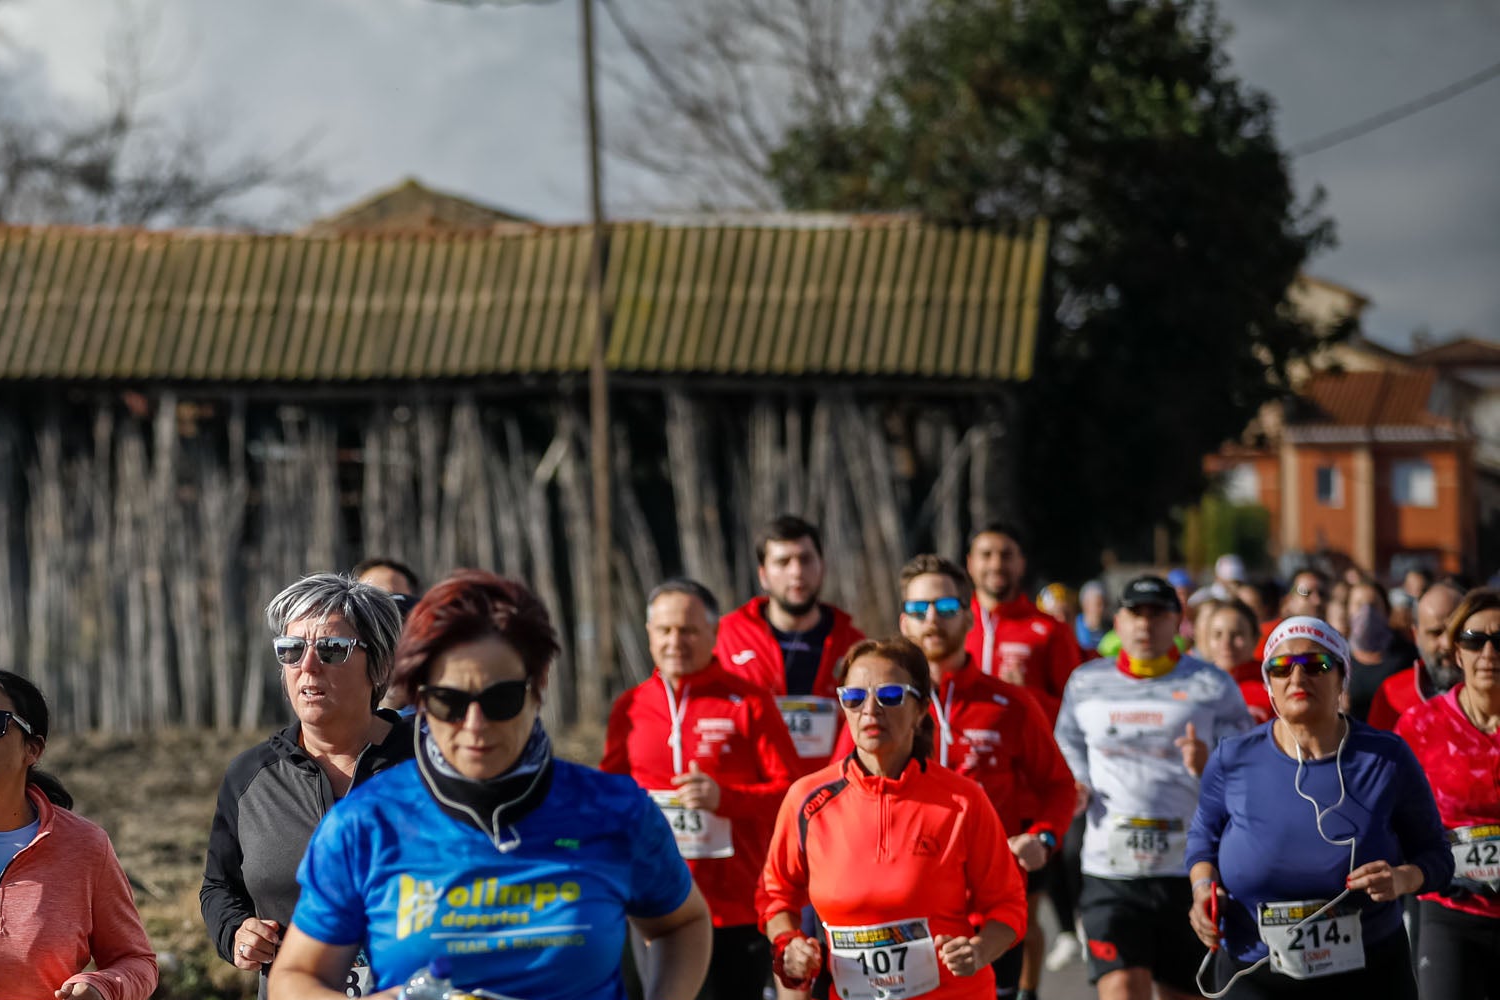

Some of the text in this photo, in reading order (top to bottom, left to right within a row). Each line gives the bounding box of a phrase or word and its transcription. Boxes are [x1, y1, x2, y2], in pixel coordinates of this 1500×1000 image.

[446, 877, 581, 911] olimpo
[441, 911, 530, 928] deportes
[857, 946, 908, 976] 107
